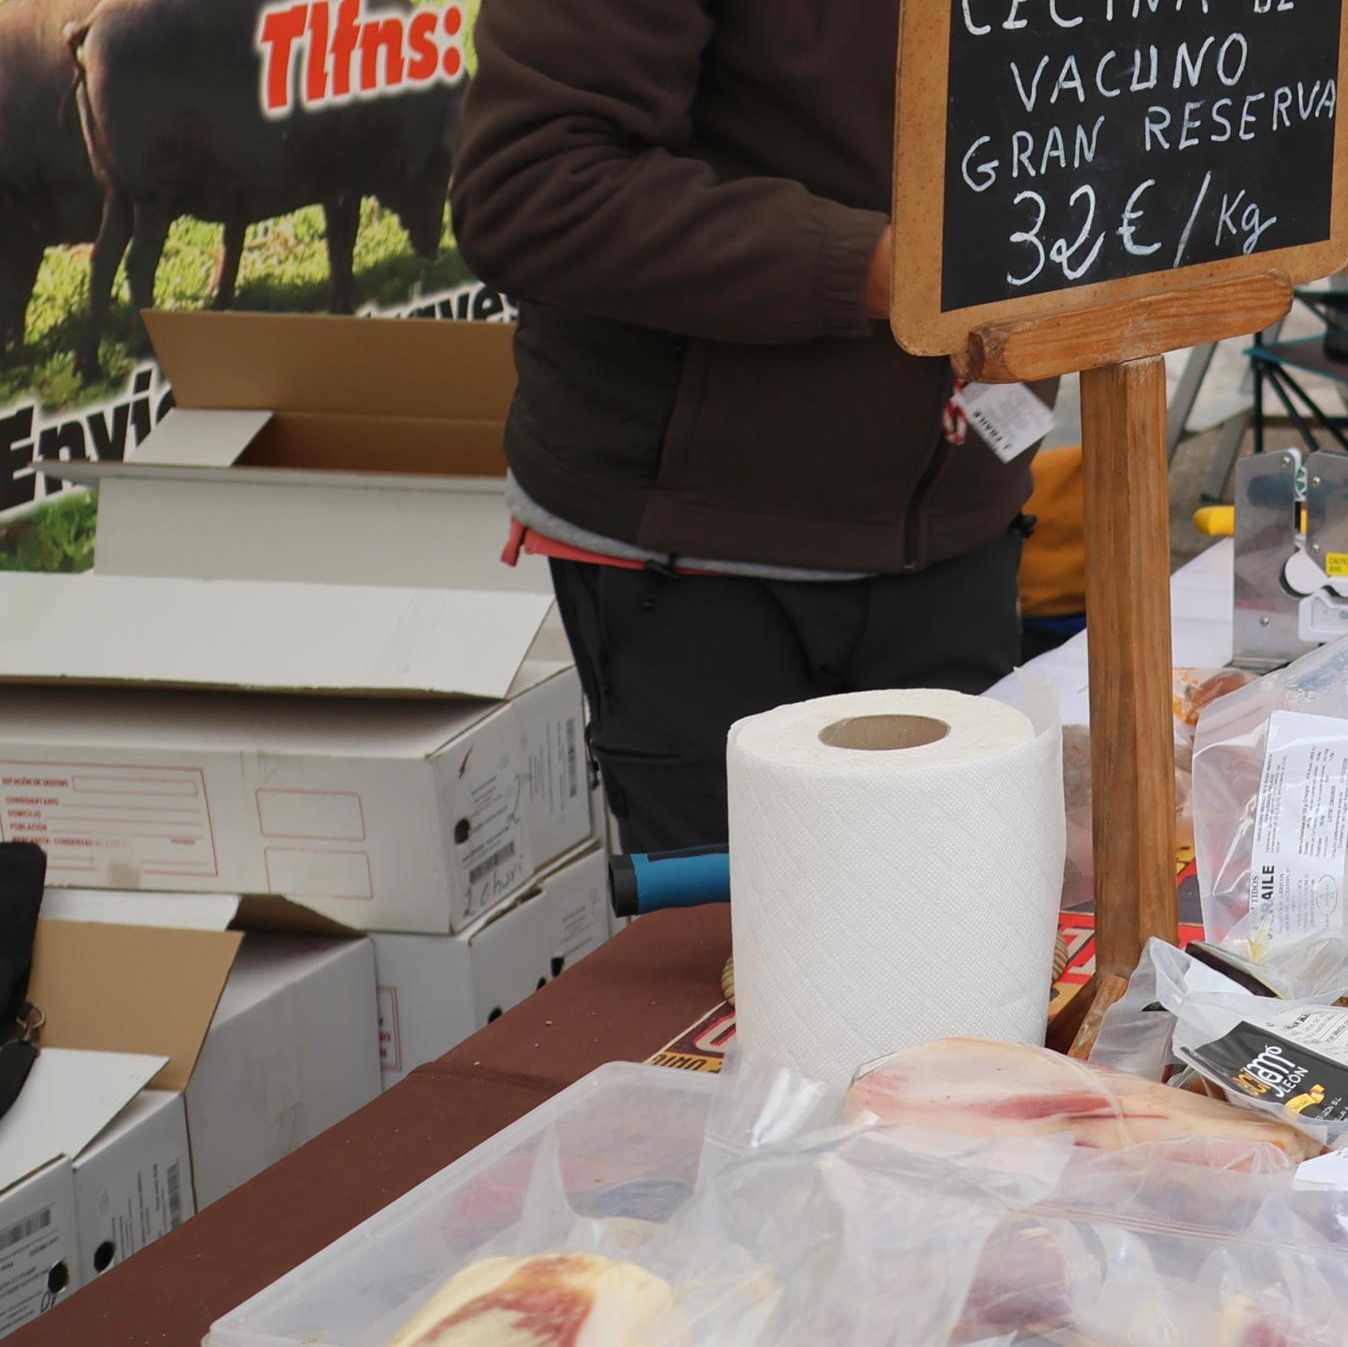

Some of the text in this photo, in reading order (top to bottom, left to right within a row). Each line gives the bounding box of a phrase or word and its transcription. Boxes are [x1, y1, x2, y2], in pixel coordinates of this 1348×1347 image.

[1010, 33, 1248, 112] VACUNO
[961, 79, 1338, 192] GRAN RESERVA
